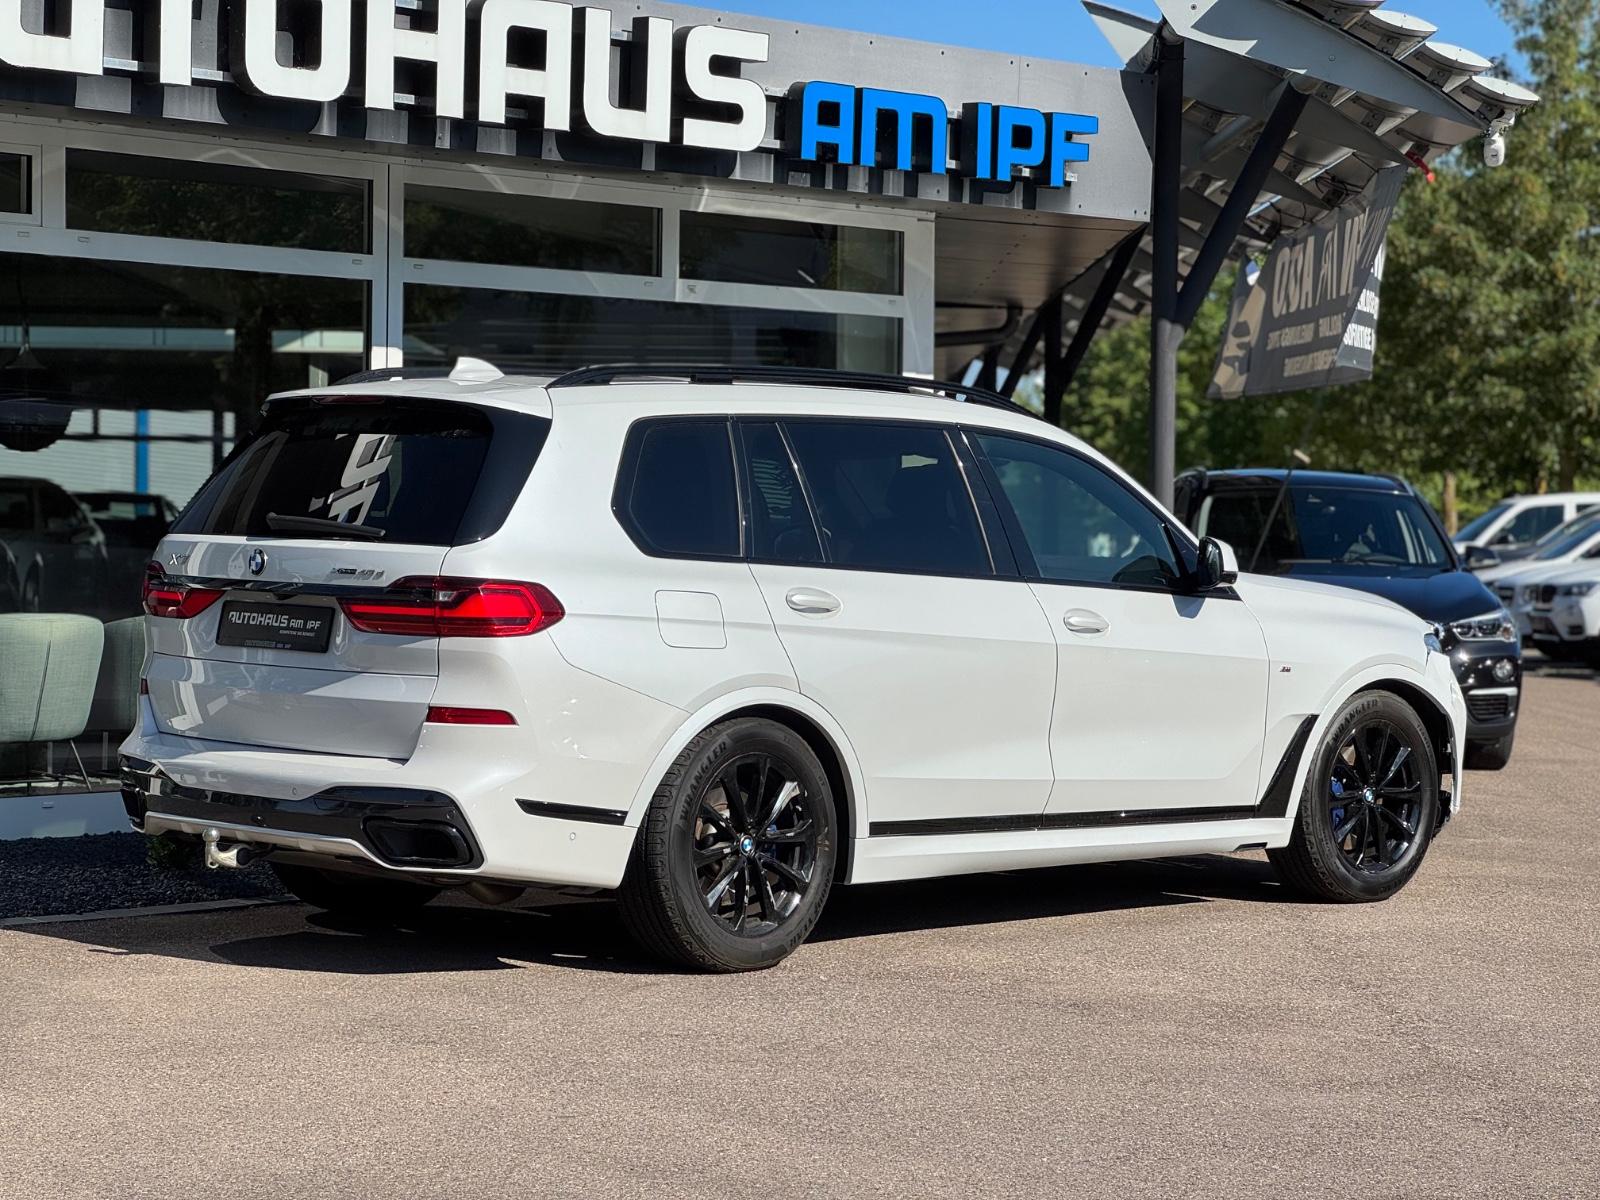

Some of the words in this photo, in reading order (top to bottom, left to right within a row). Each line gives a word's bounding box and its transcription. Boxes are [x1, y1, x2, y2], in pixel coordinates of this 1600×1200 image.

[800, 80, 948, 175] AM
[975, 101, 1099, 188] IPF
[229, 611, 289, 627] AUTOHAUS
[289, 619, 304, 629] AM
[306, 620, 322, 630] IPF
[1331, 699, 1378, 743] WRANGLER
[680, 741, 727, 820] WRANGLER
